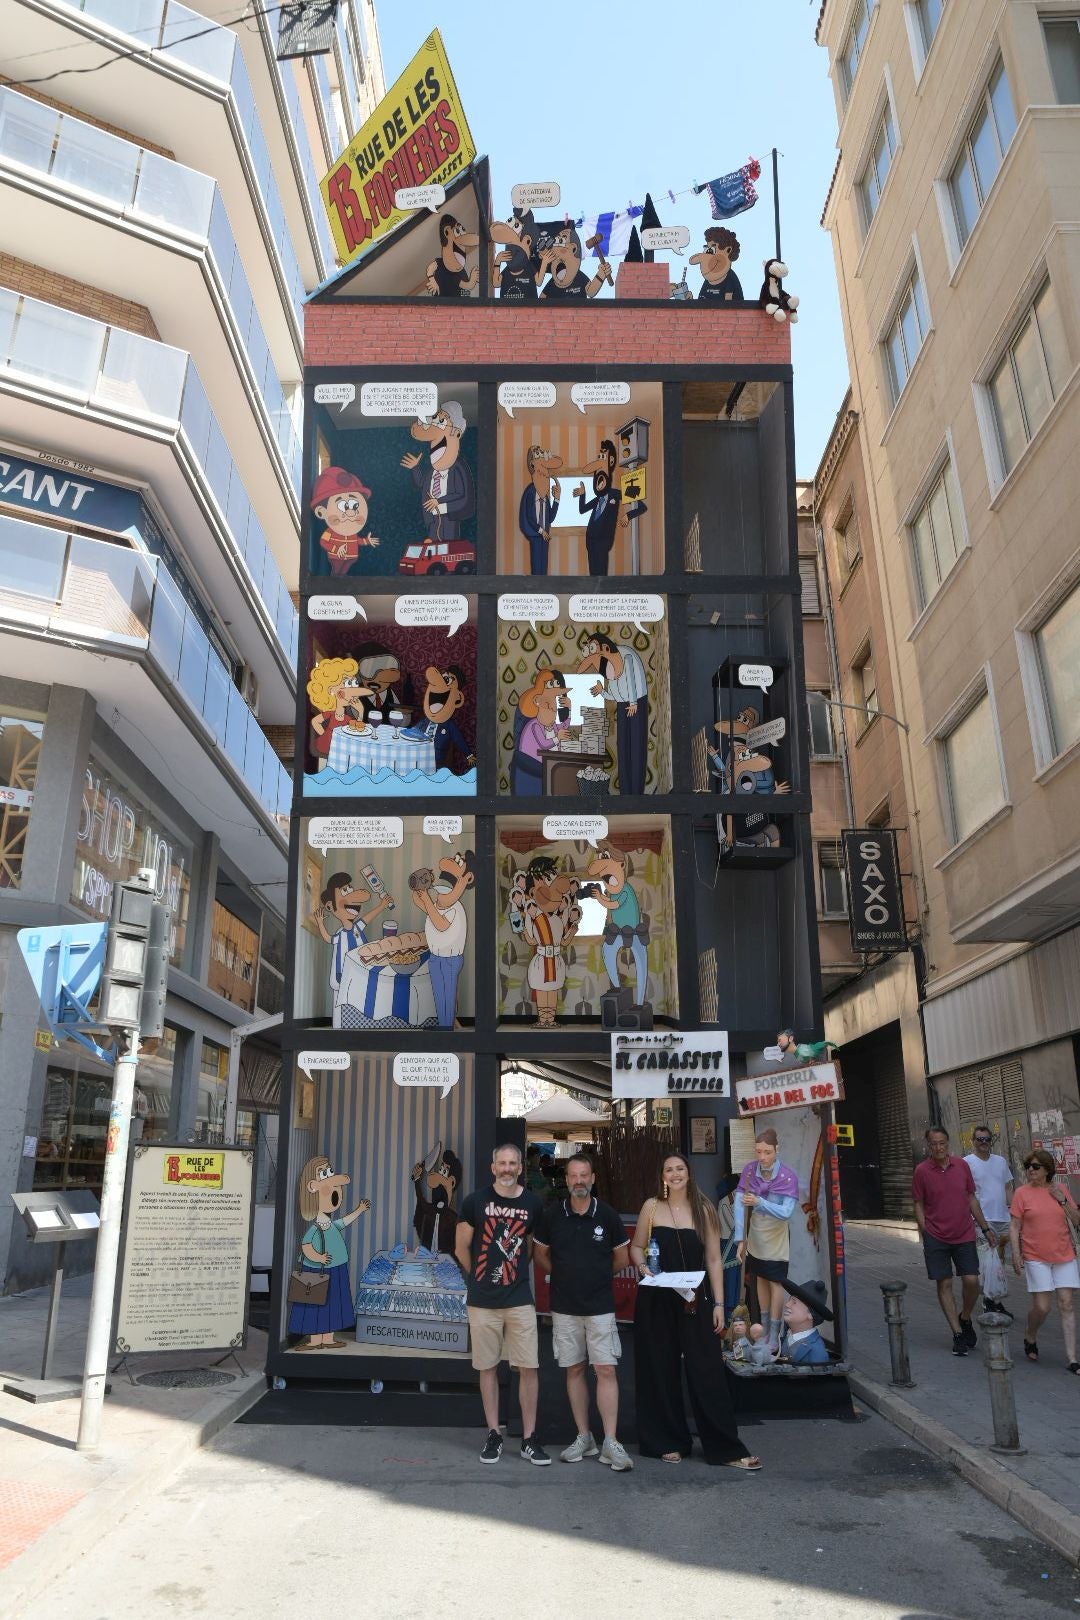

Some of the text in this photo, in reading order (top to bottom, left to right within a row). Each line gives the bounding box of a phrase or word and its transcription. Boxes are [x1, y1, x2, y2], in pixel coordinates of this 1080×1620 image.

[355, 66, 441, 181] RUE DE LES
[363, 99, 460, 228] FOGUERES
[72, 462, 95, 474] 1982
[77, 768, 135, 869] SHOP
[859, 841, 890, 925] SAXO
[857, 932, 875, 940] SHOES
[882, 931, 901, 939] BOOTS
[615, 1050, 723, 1070] EL CABASSET
[667, 1072, 724, 1091] barraca
[754, 1068, 817, 1092] PORTERIA
[740, 1082, 834, 1112] ELLEA DEL FOC
[186, 1157, 215, 1167] RUE DE
[366, 1325, 459, 1343] PESCATERIA MANOLITO
